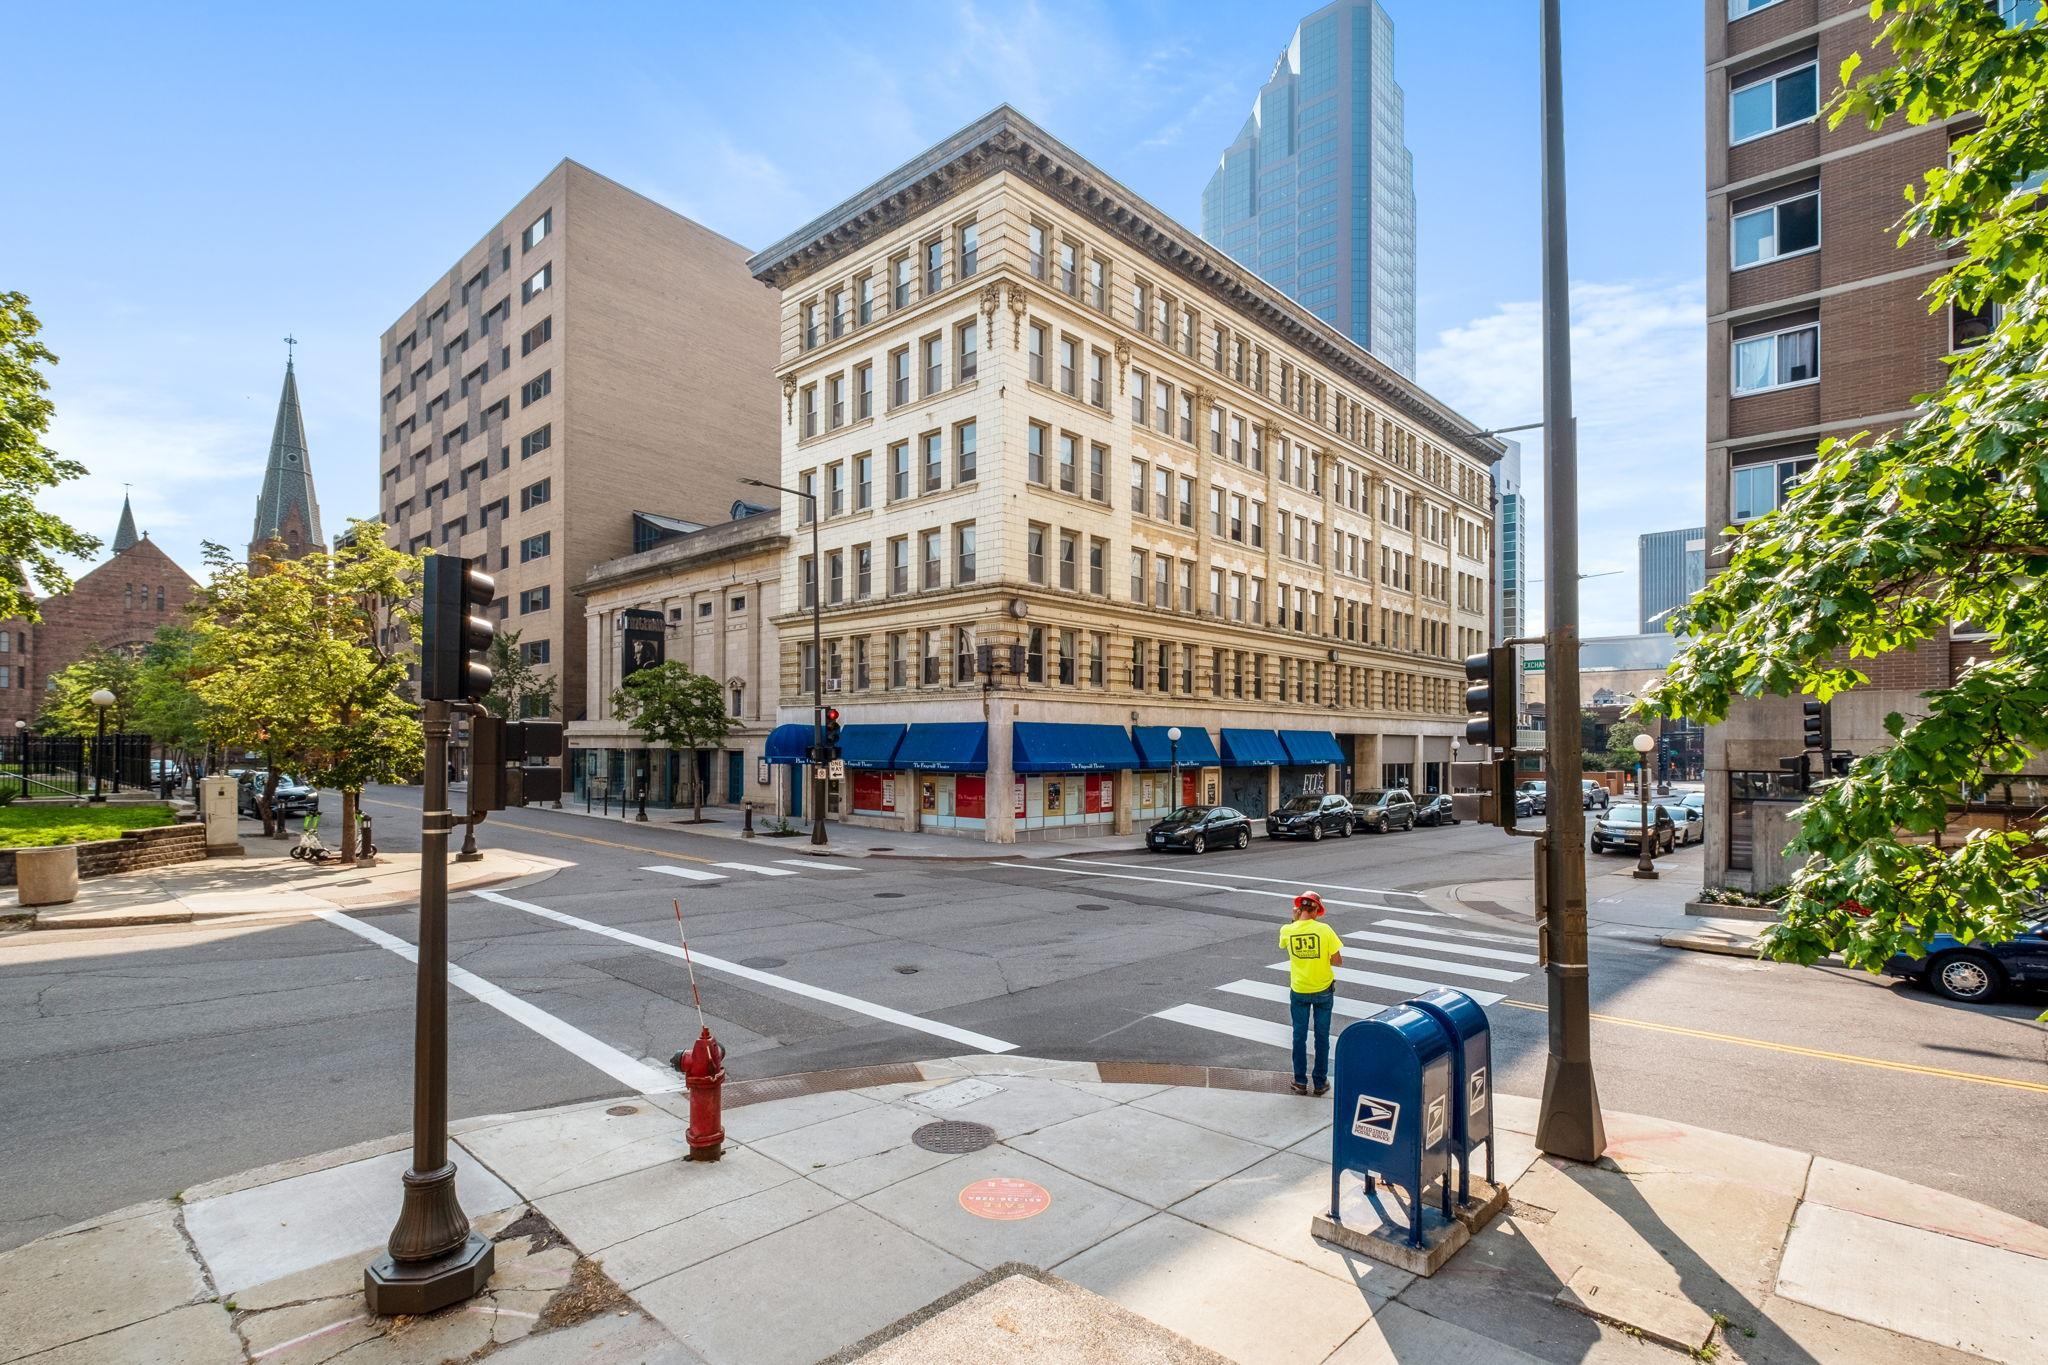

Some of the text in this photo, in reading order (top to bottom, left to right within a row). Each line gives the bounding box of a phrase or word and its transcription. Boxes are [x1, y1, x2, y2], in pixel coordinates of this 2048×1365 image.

[1354, 1129, 1391, 1142] POSTAL SERVICE
[1355, 1123, 1389, 1137] UNITED STATES
